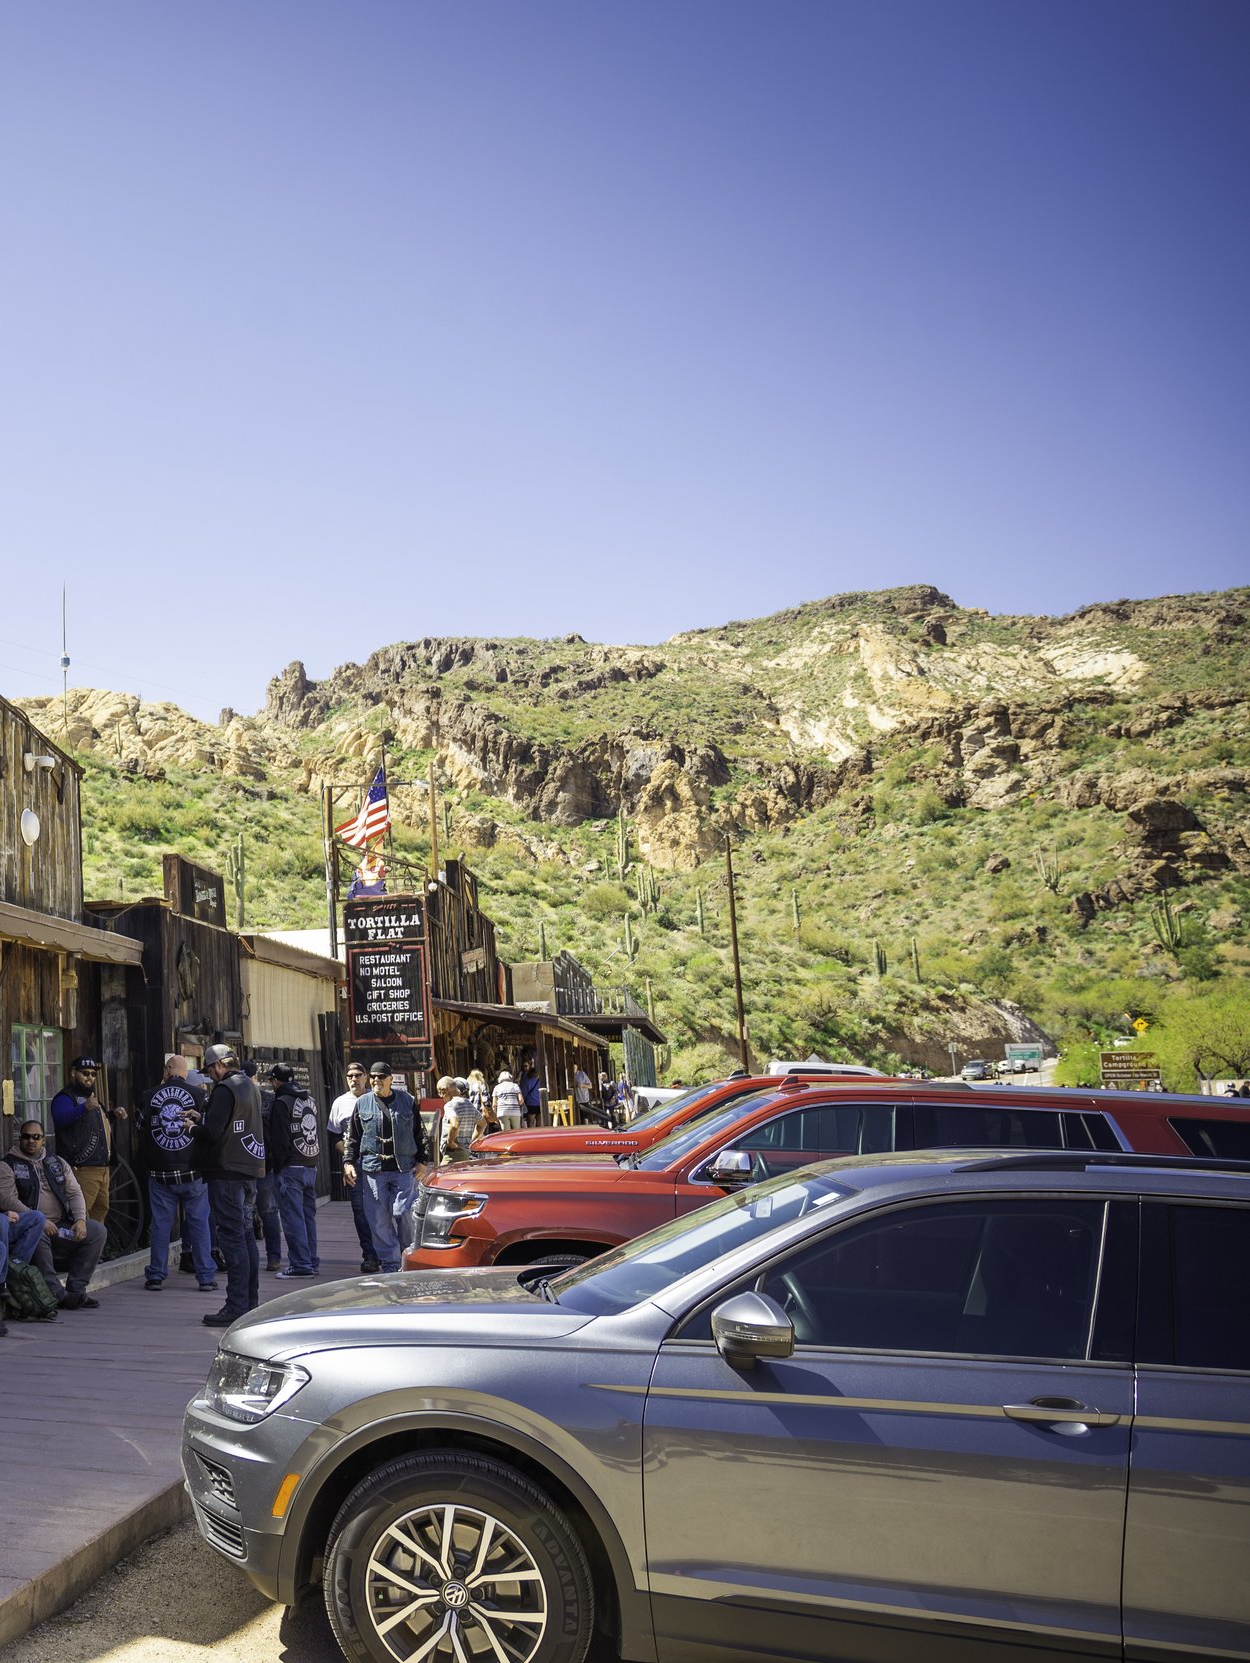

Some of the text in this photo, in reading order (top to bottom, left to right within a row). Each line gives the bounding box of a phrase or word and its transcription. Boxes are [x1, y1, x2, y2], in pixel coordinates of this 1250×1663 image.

[348, 914, 420, 929] TORTILLA
[367, 927, 404, 940] FLAT
[359, 953, 411, 965] RESTAURANT
[360, 966, 400, 976] NO MOTEL
[371, 977, 403, 988] SALOON
[367, 989, 410, 1000] GIFT SHOP
[367, 1000, 409, 1011] GROCERIES
[394, 1012, 423, 1022] OFFICE
[152, 1088, 192, 1105] PUNISHERS
[156, 1133, 190, 1149] ARIZONA
